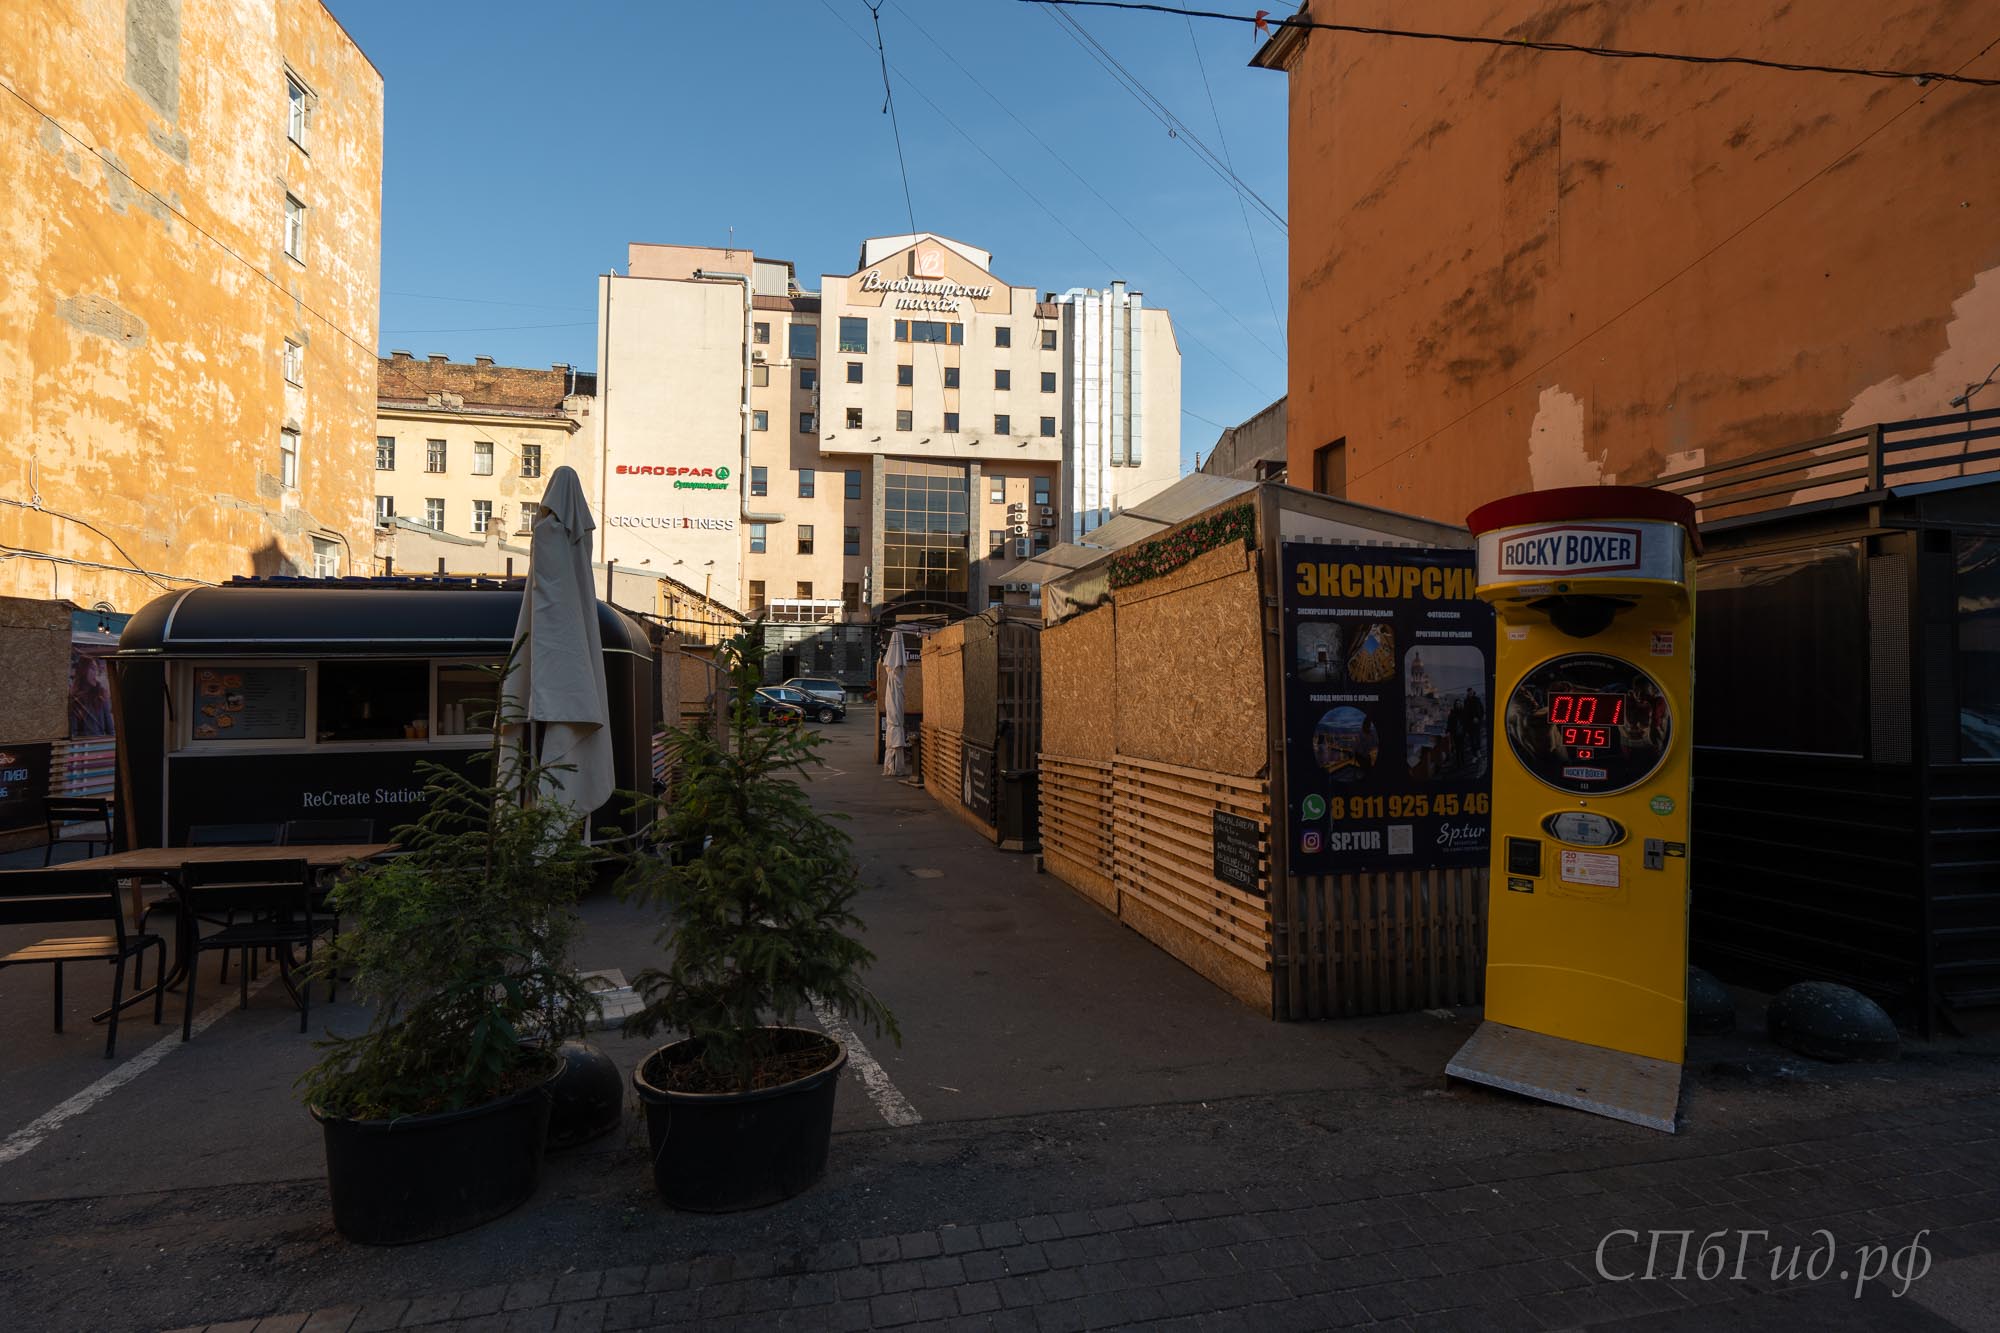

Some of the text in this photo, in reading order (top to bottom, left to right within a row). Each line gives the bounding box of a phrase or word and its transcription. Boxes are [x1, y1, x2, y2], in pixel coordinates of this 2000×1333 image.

[863, 269, 993, 299] Владимирский
[897, 297, 961, 312] пассаж
[615, 465, 713, 477] EUROSPAR
[610, 516, 671, 529] CROCUS
[1505, 535, 1632, 565] ROCKY BOXER
[1565, 728, 1605, 746] 975
[303, 787, 426, 808] ReCreate Station
[1330, 792, 1489, 820] 8 911 925 45 46
[1331, 831, 1381, 851] SP.TUR
